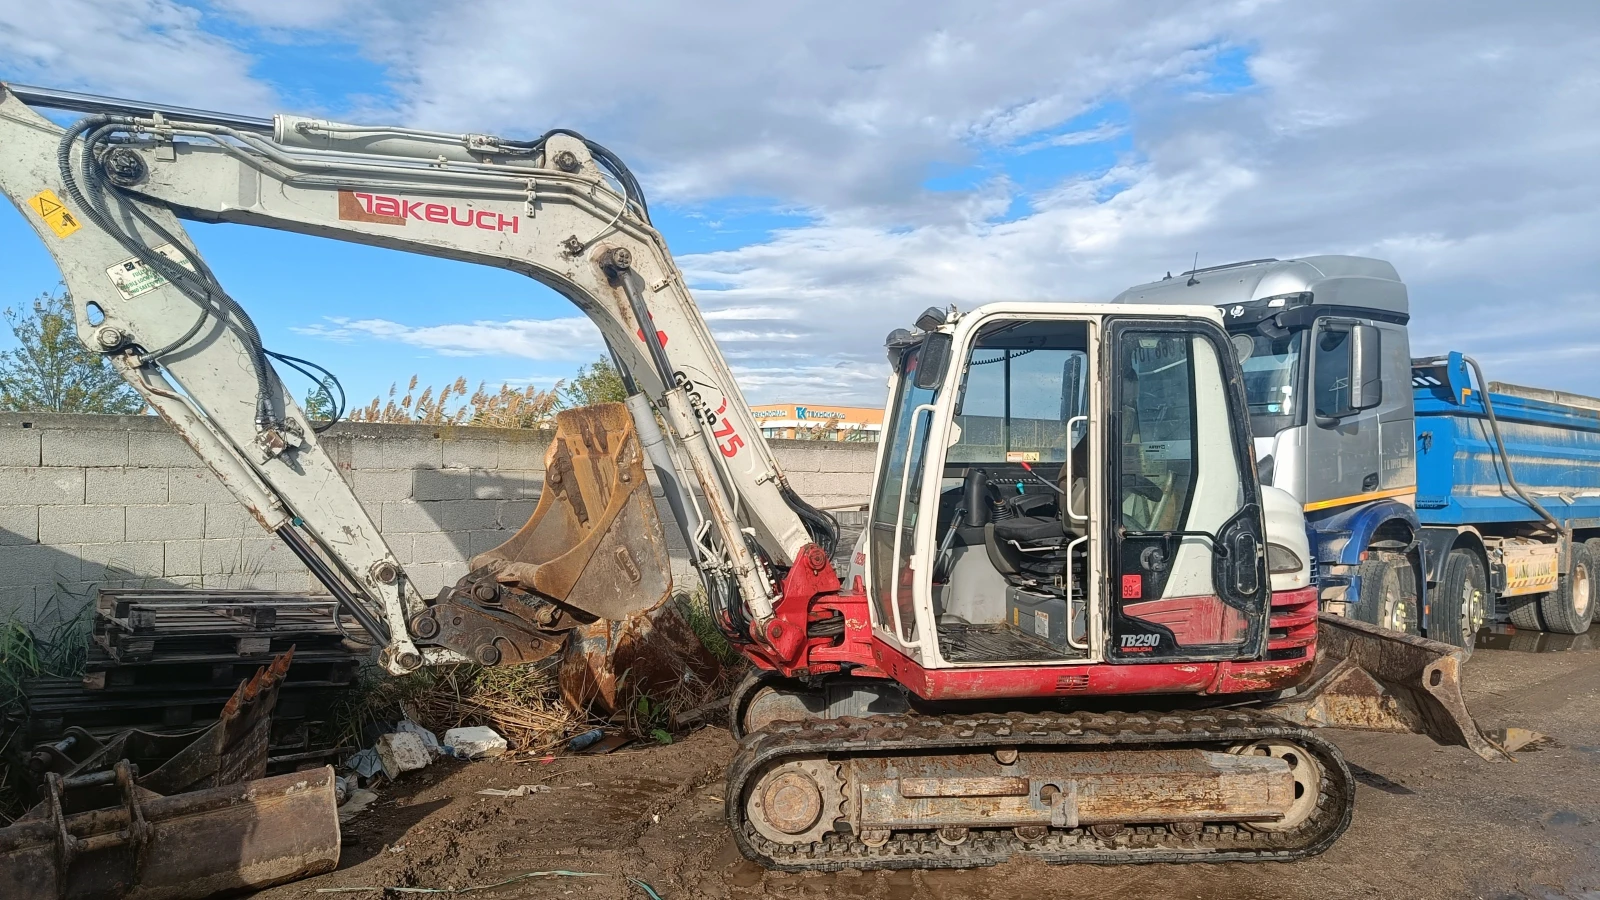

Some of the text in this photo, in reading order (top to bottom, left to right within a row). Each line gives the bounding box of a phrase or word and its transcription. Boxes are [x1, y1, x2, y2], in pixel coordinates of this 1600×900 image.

[714, 417, 745, 457] 75
[1124, 585, 1133, 597] 99
[1120, 633, 1161, 647] TB290
